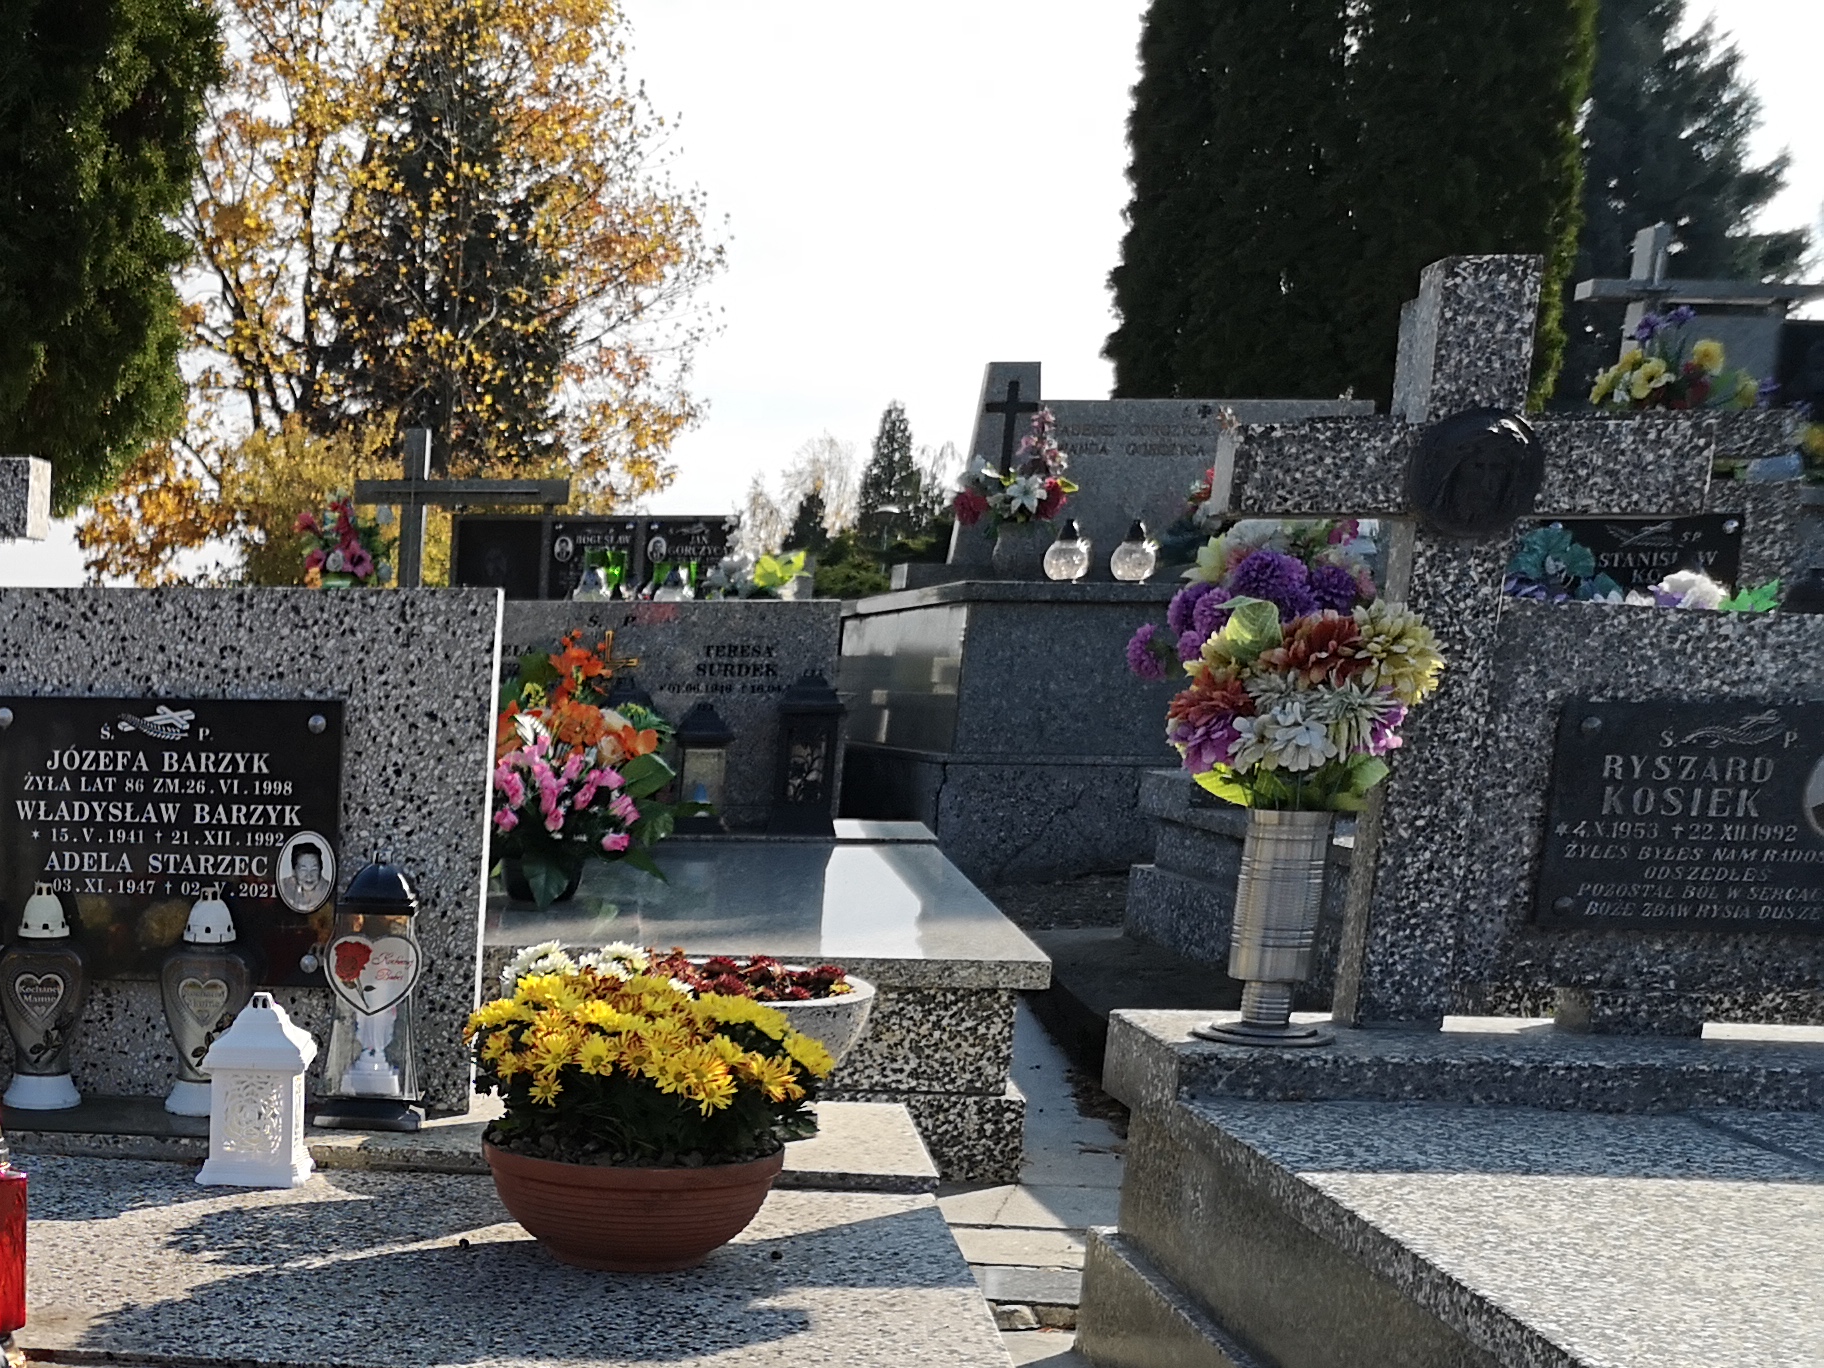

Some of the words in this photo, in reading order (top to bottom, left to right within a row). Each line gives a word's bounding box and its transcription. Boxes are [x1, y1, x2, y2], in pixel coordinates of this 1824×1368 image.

[703, 644, 774, 658] TERESA
[47, 745, 149, 772] JÓZEFA
[162, 751, 270, 774] BARZYK
[1602, 754, 1775, 782] RYSZARD
[24, 772, 71, 792] ŻYŁA
[80, 777, 116, 793] LAT
[125, 779, 144, 793] 86
[16, 800, 181, 824] WŁADYSŁAW
[193, 805, 302, 826] BARZYK
[1601, 786, 1761, 818] KOSIEK
[45, 851, 133, 873] ADELA
[148, 854, 268, 877] STARZEC
[1712, 848, 1757, 862] NAM
[1726, 886, 1742, 899] W
[1747, 887, 1824, 902] SERCAC
[1641, 903, 1693, 917] ZBAW
[1695, 904, 1750, 918] RYSIA
